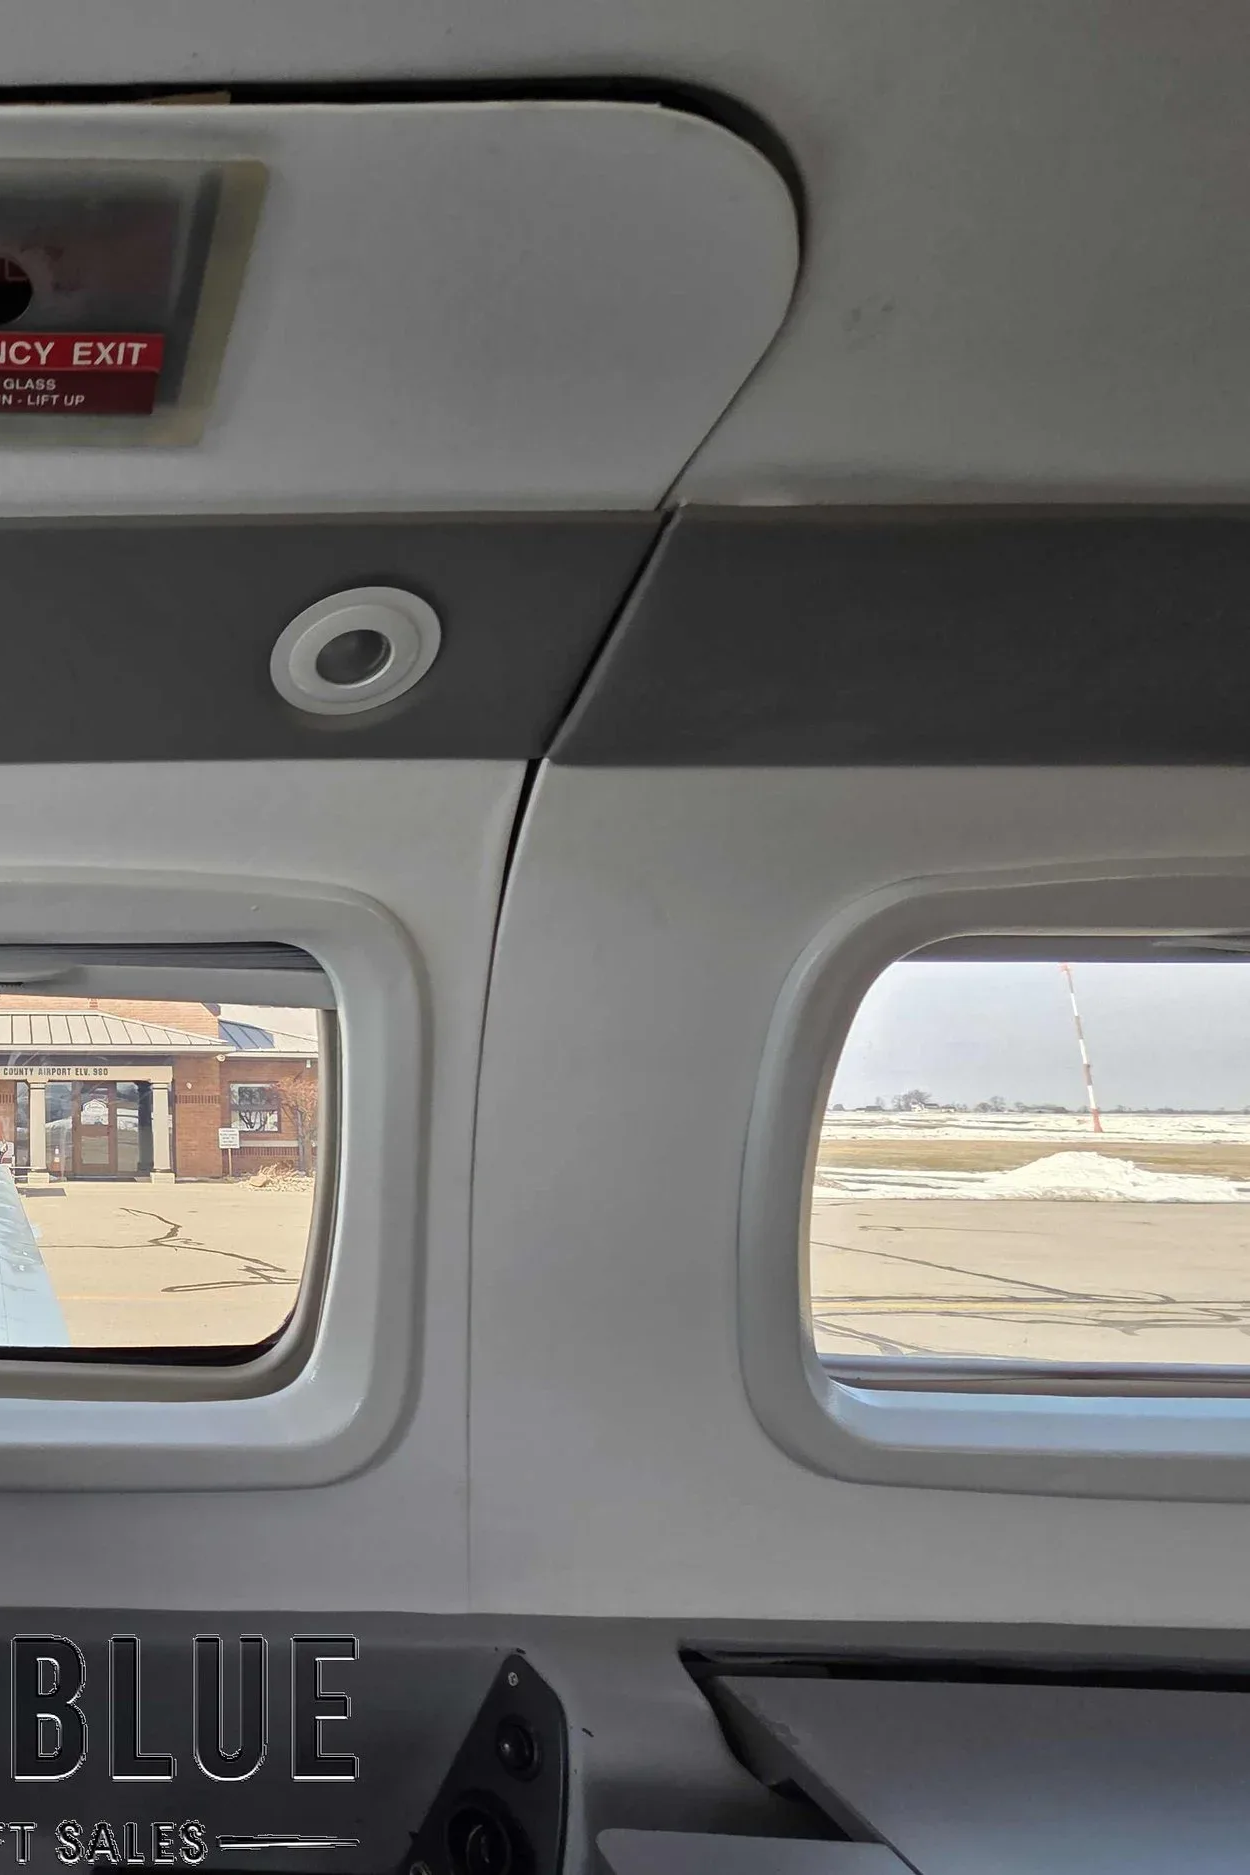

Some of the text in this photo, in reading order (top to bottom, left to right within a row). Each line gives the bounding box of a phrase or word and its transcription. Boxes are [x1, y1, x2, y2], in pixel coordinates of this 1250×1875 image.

[72, 341, 148, 366] EXIT
[3, 378, 57, 391] GLASS
[26, 394, 60, 407] LIFT
[63, 395, 85, 407] UP
[3, 1067, 34, 1076] COUNTY
[37, 1067, 72, 1076] AIRPORT
[75, 1067, 91, 1076] ELV.
[93, 1067, 109, 1076] 980
